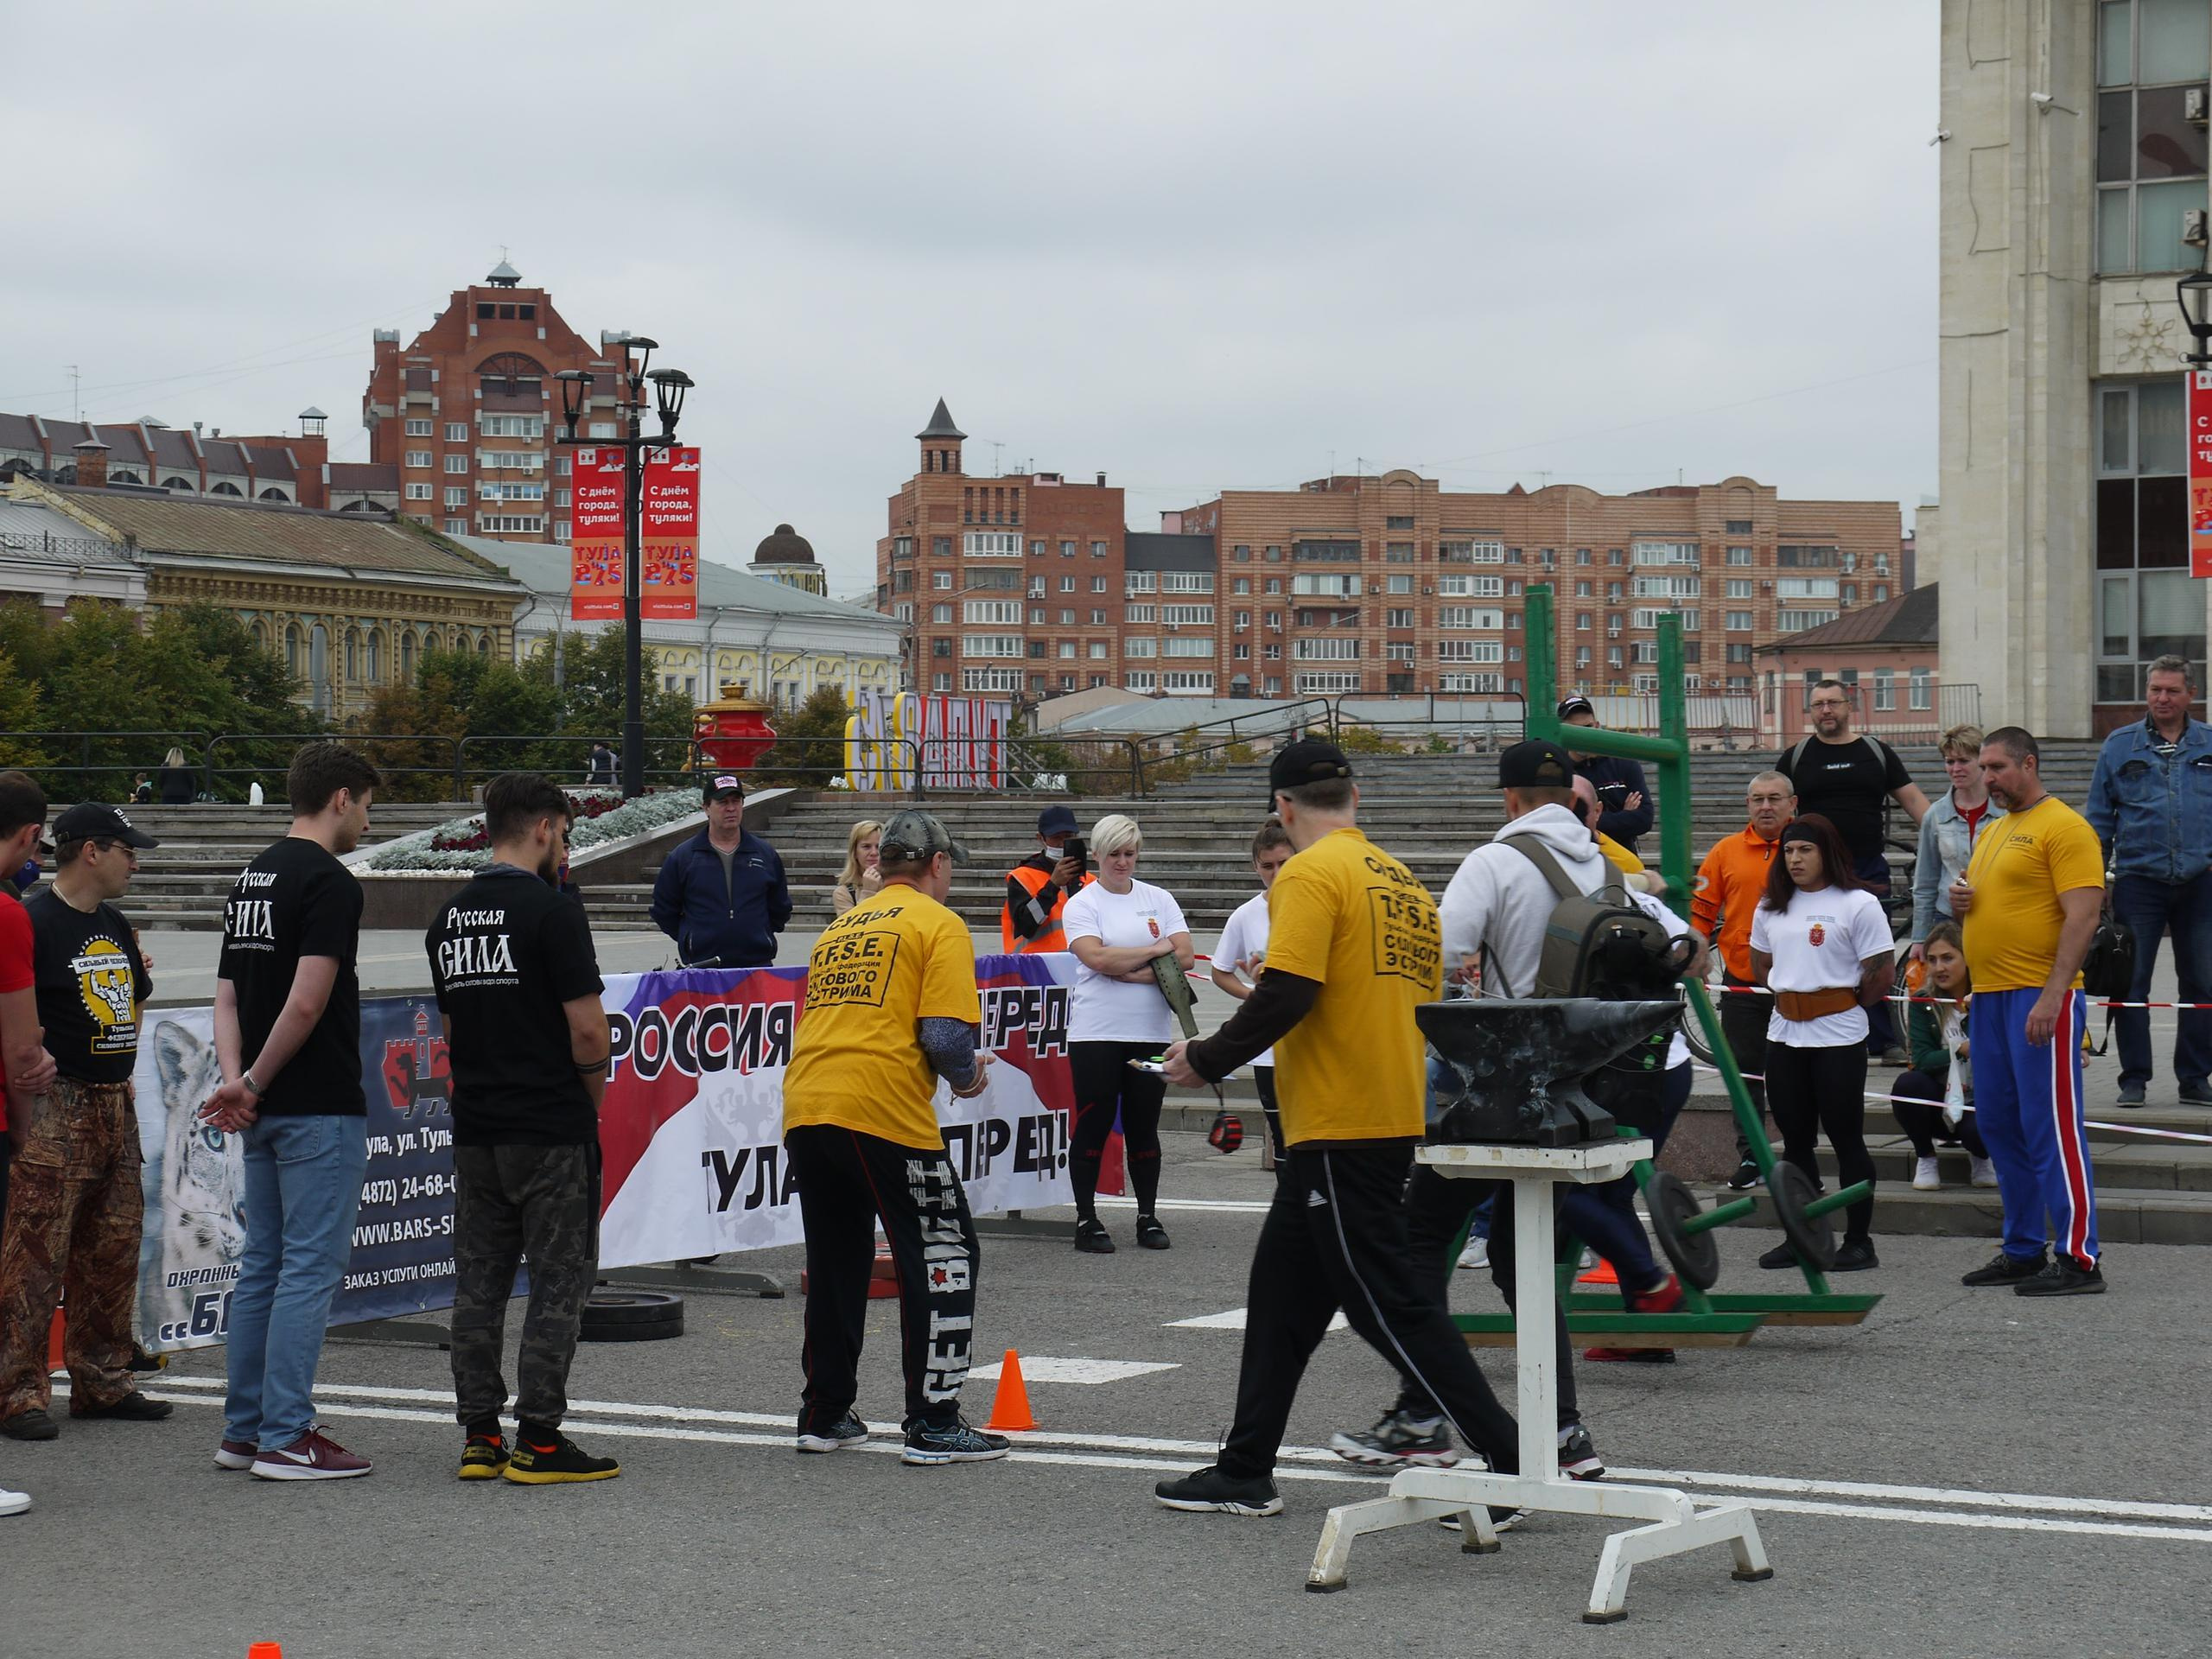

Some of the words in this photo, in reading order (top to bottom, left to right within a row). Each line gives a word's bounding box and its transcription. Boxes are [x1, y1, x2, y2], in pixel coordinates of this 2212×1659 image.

[578, 487, 587, 496] С
[588, 486, 615, 497] днём
[650, 486, 658, 495] С
[661, 486, 689, 497] днём
[650, 501, 692, 511] города,
[650, 513, 693, 524] туляки!
[578, 513, 620, 525] туляки!
[575, 563, 622, 587] 875
[645, 562, 695, 586] 875
[446, 906, 505, 934] Русская
[828, 906, 905, 931] СУДЬЯ
[437, 934, 518, 980] СИЛА
[605, 1001, 795, 1083] РОССИЯ
[397, 1133, 417, 1157] ул.
[420, 1126, 453, 1154] Туль
[702, 1145, 801, 1214] УЛА
[344, 1273, 379, 1290] ЗАКАЗ
[382, 1265, 418, 1285] УСЛУГИ
[420, 1257, 456, 1278] ОНЛАЙ
[922, 1309, 973, 1404] GET
